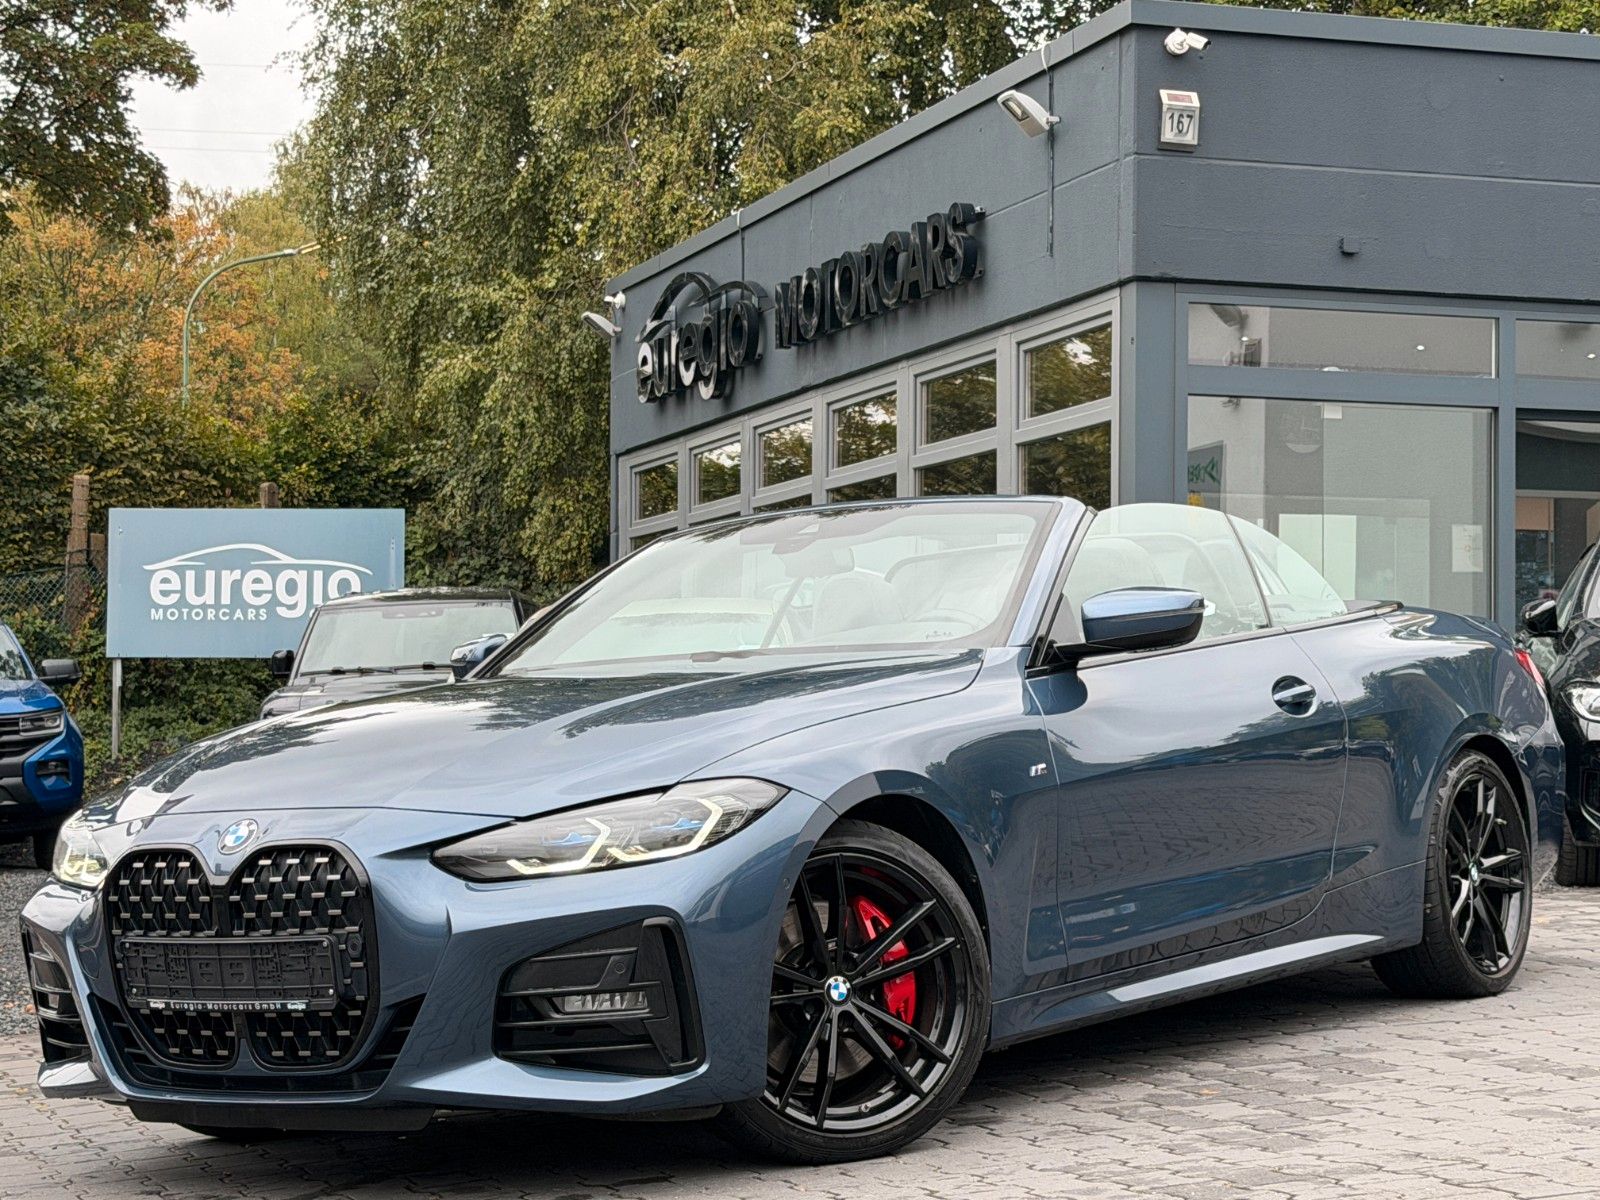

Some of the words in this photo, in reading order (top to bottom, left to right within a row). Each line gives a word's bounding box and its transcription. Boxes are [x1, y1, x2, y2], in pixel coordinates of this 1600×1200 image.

[1168, 112, 1194, 134] 167
[636, 292, 760, 403] euregio
[775, 202, 977, 349] MOTORCARS
[149, 569, 362, 618] euregio
[150, 608, 268, 621] MOTORCARS
[254, 1001, 282, 1010] GmbH
